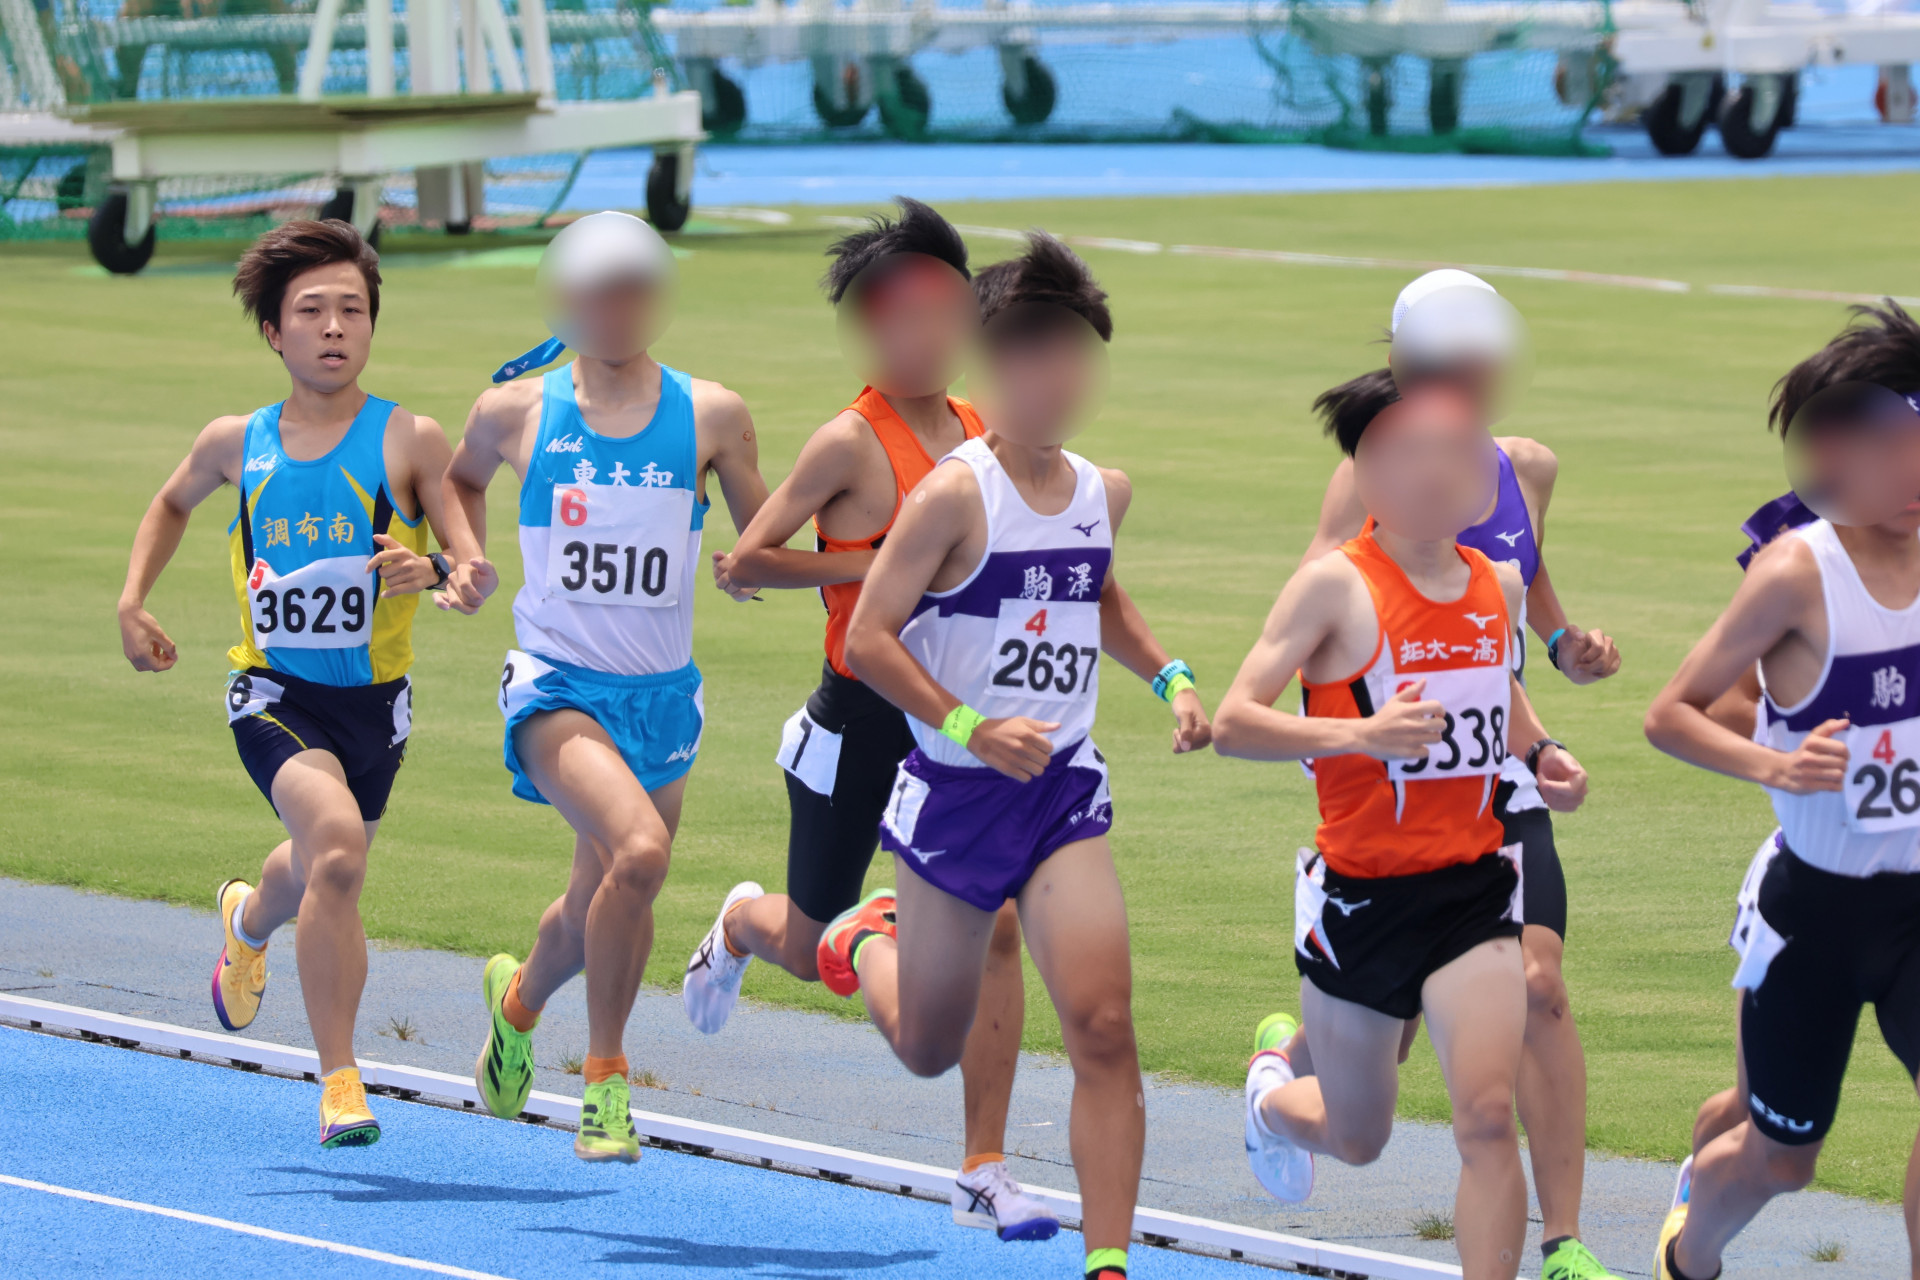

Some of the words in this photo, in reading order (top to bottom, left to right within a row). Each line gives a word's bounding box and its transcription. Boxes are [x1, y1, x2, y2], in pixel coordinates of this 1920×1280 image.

[560, 488, 588, 526] 6
[261, 511, 354, 549] 調布南
[250, 560, 269, 590] 5
[561, 541, 668, 597] 3510
[1019, 562, 1093, 601] 駒澤
[256, 586, 365, 633] 3629
[1024, 608, 1048, 637] 4
[992, 638, 1098, 695] 2637
[1400, 634, 1498, 666] 拓大一高
[1401, 705, 1505, 774] 338
[1872, 729, 1896, 765] 4
